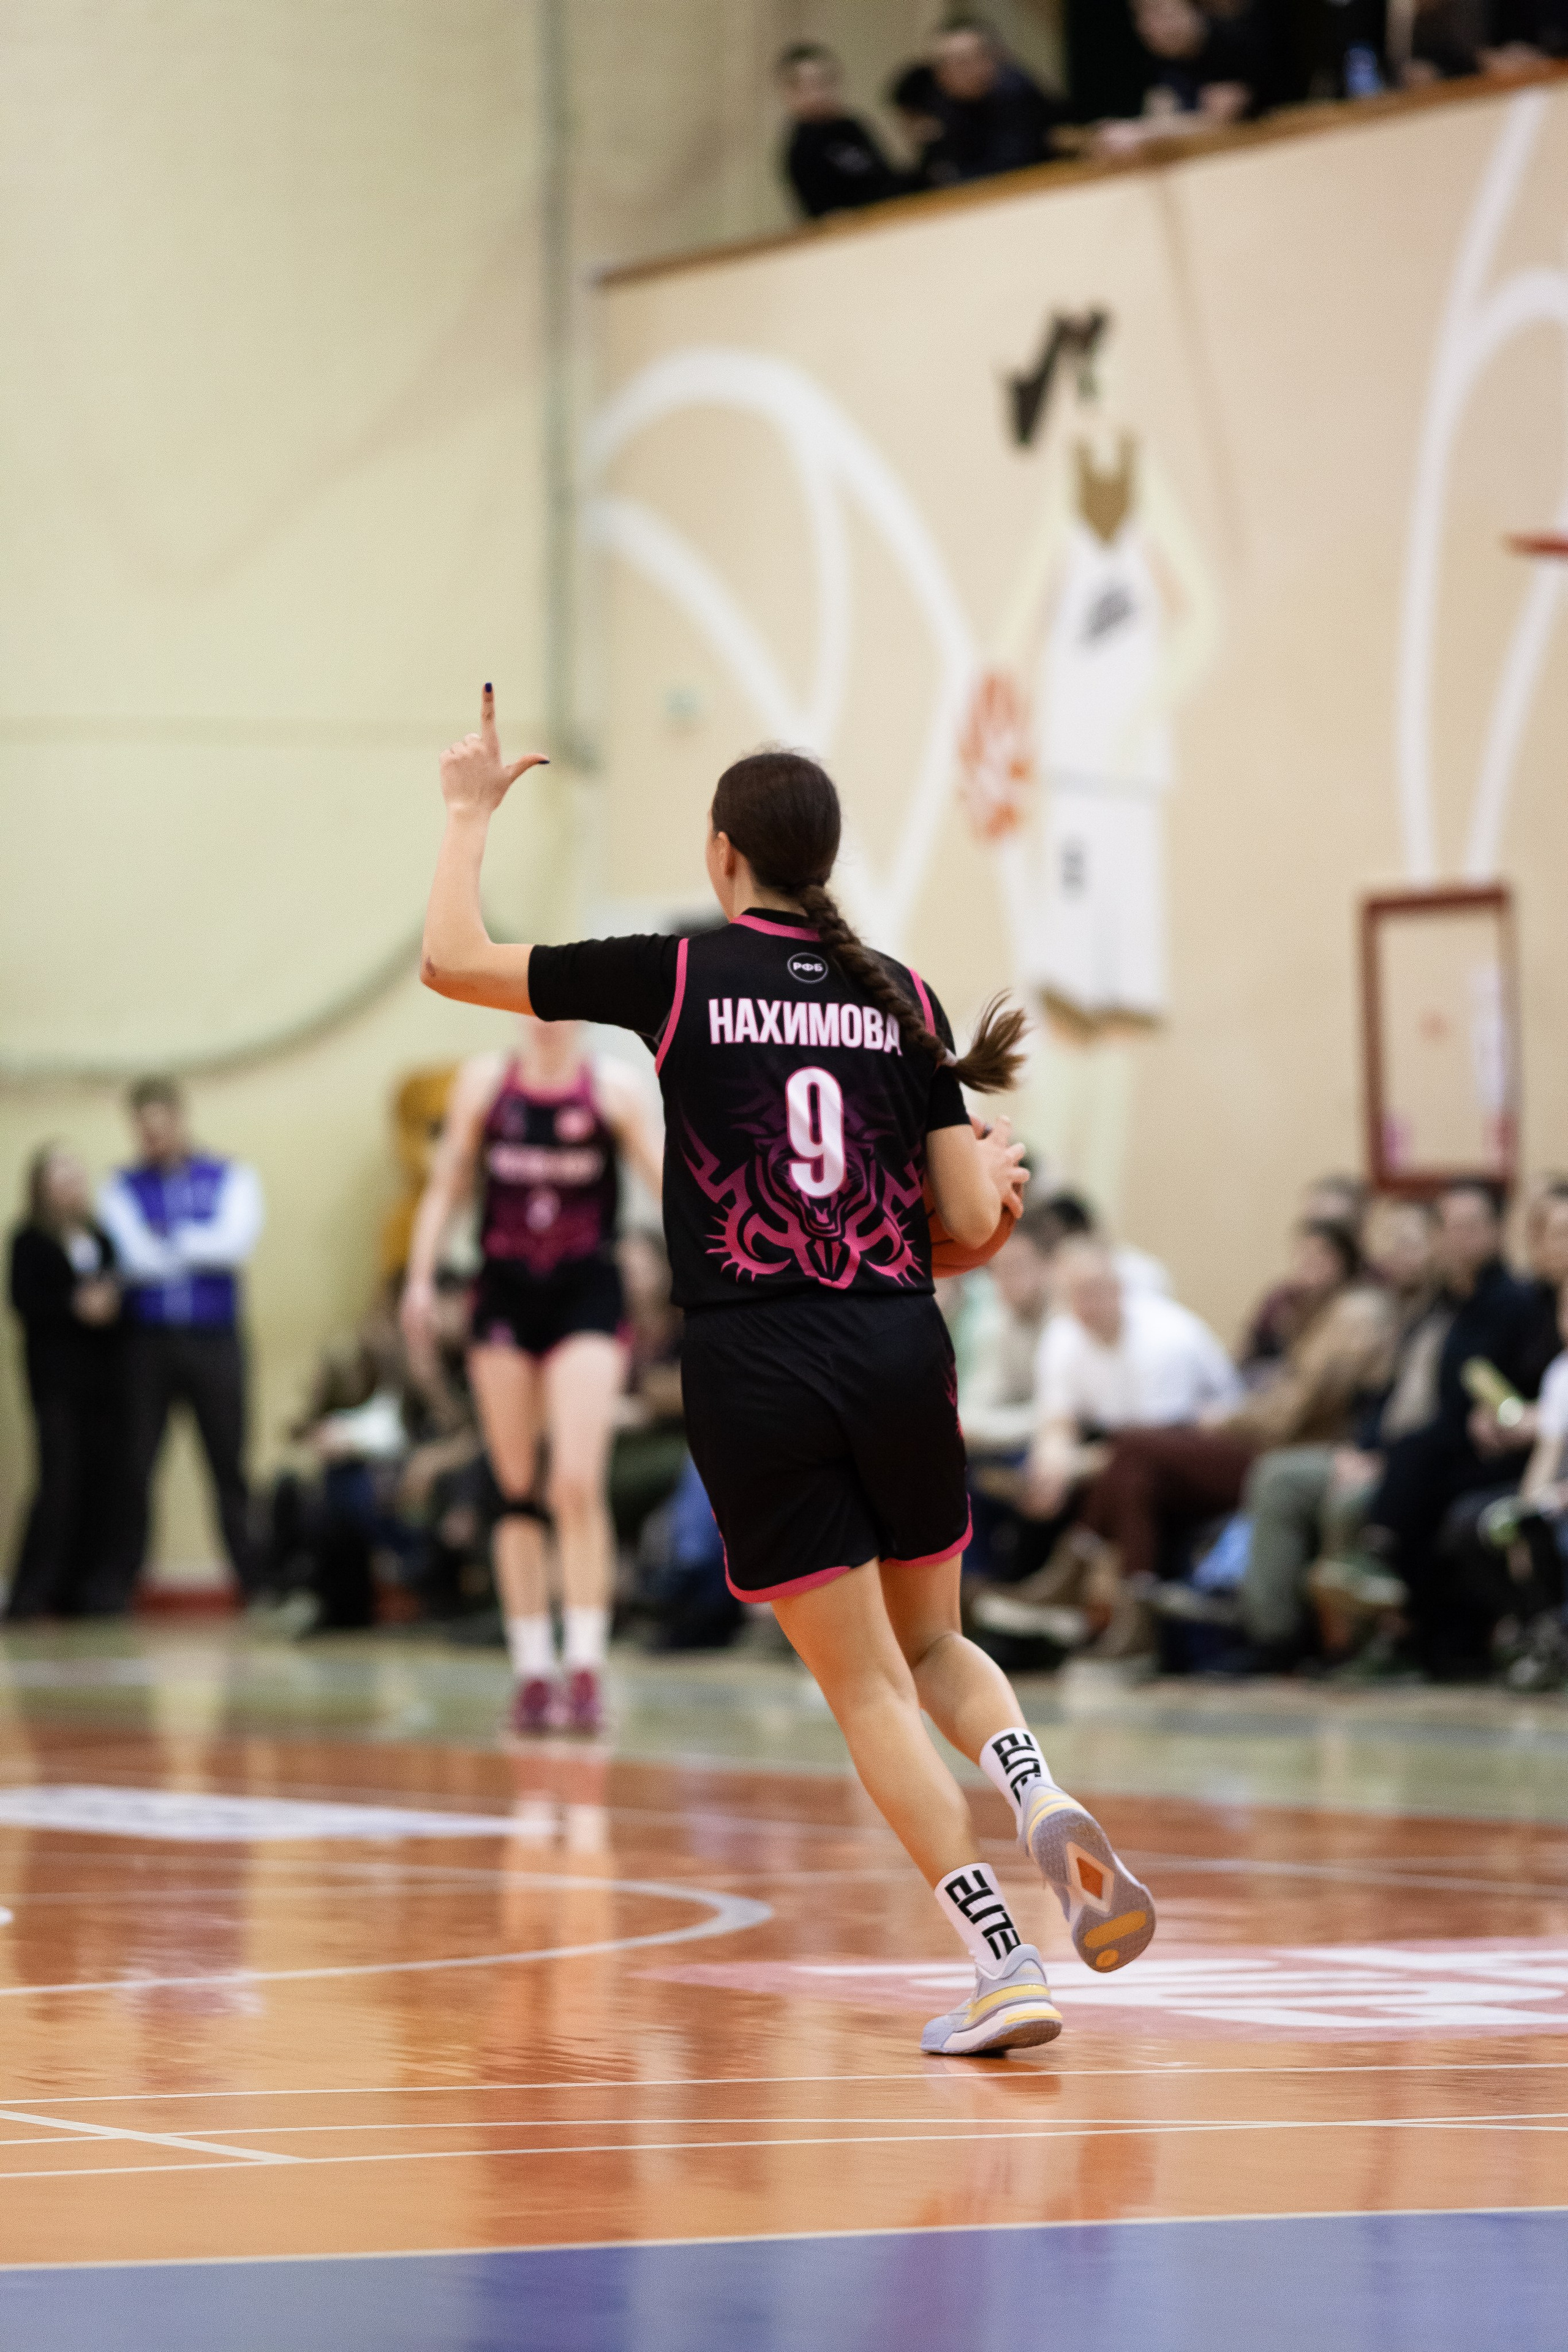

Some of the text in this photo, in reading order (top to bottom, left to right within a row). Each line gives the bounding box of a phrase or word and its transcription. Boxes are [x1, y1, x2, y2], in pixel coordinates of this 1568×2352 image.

[793, 962, 823, 973] РФБ
[709, 998, 903, 1057] НАХИМОВА
[786, 1066, 845, 1197] 9
[944, 1869, 1022, 1960] ELITE
